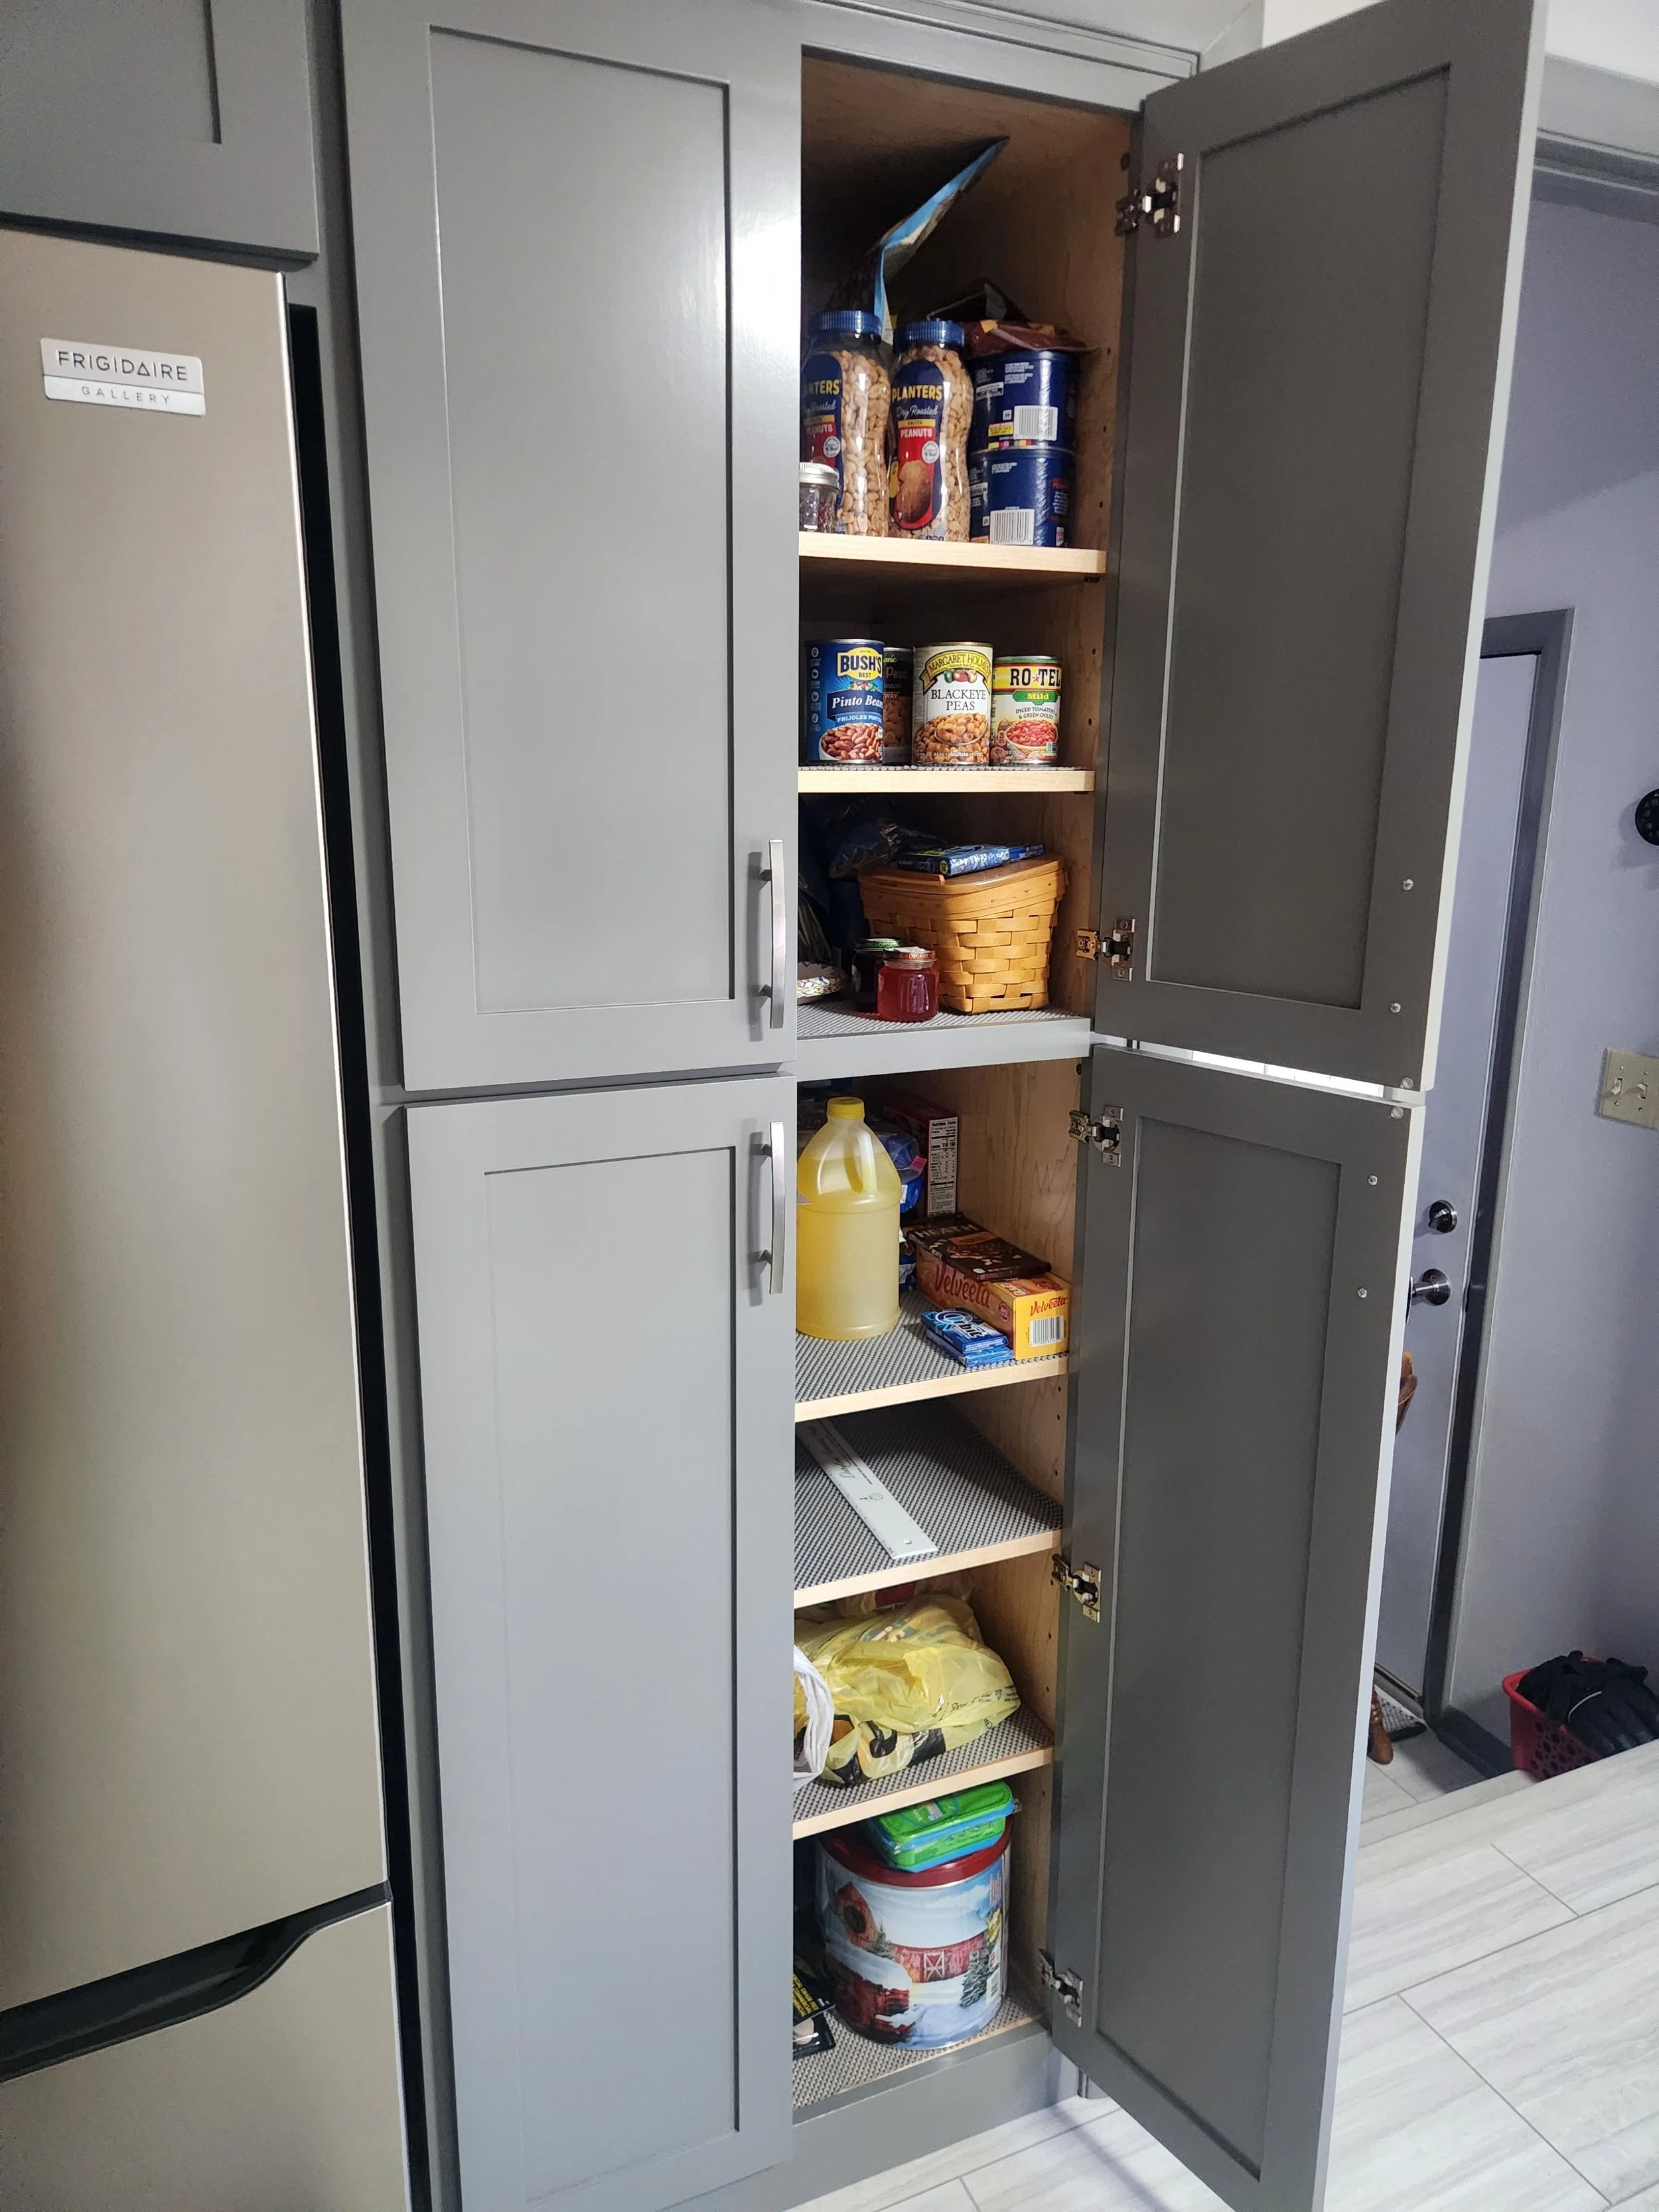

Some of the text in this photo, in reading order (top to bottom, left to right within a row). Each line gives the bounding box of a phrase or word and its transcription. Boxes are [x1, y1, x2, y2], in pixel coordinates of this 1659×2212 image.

[57, 350, 187, 381] FRIGIDAIRE
[82, 386, 170, 404] GALLERY
[891, 385, 942, 403] PLANTERS
[896, 405, 938, 419] Dry Roasted
[901, 428, 932, 438] PEANUTS
[840, 655, 882, 674] BUSH'S
[928, 654, 989, 673] MARGARET HOLMES
[831, 696, 863, 709] Pinto
[931, 690, 986, 700] BLACKEYE
[946, 701, 975, 711] PEAS
[914, 1224, 979, 1238] HEATH
[934, 1264, 990, 1309] Velveeta
[1030, 1295, 1068, 1317] Velveeta
[935, 1311, 987, 1339] Orbit
